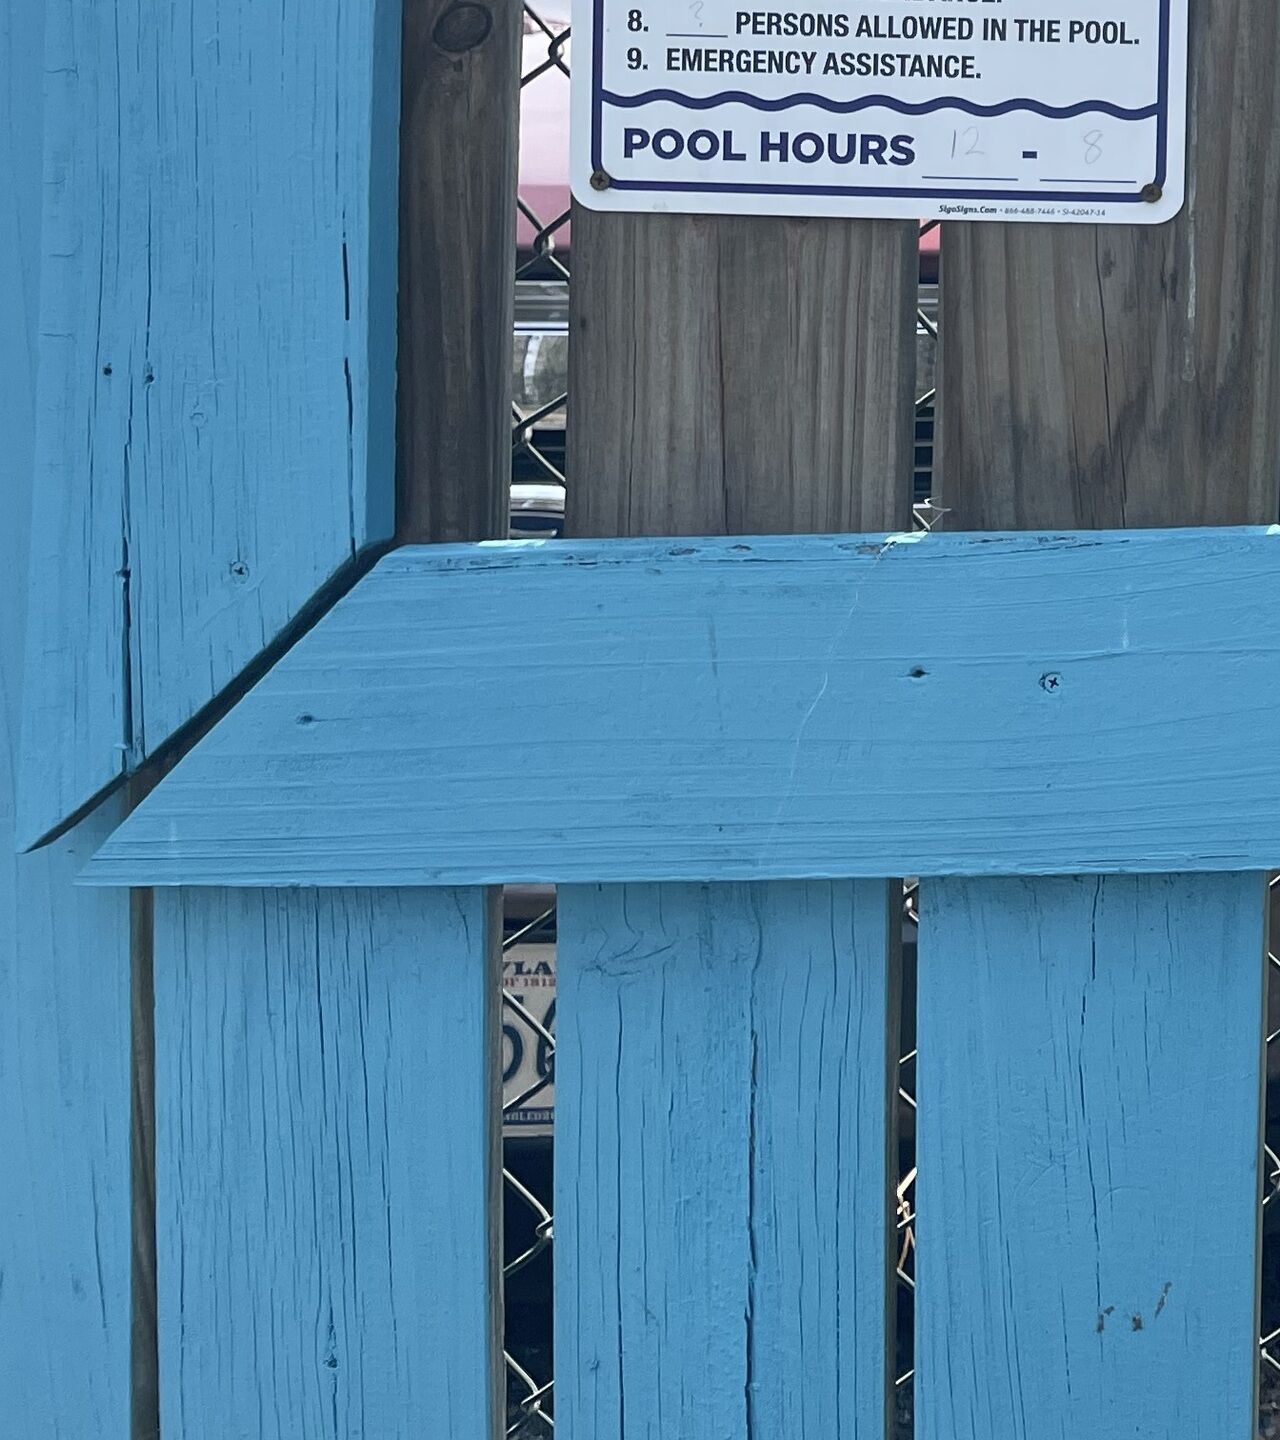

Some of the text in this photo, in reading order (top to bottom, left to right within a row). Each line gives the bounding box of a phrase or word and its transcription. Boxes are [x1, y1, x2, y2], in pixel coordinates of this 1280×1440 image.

[627, 9, 1140, 45] 8. PERSONS ALLOWED IN THE POOL.
[627, 47, 982, 79] 9. EMERGENCY ASSISTANCE.
[623, 127, 746, 162] POOL
[759, 130, 915, 166] HOURS
[951, 126, 985, 160] 12
[1082, 129, 1104, 164] 8
